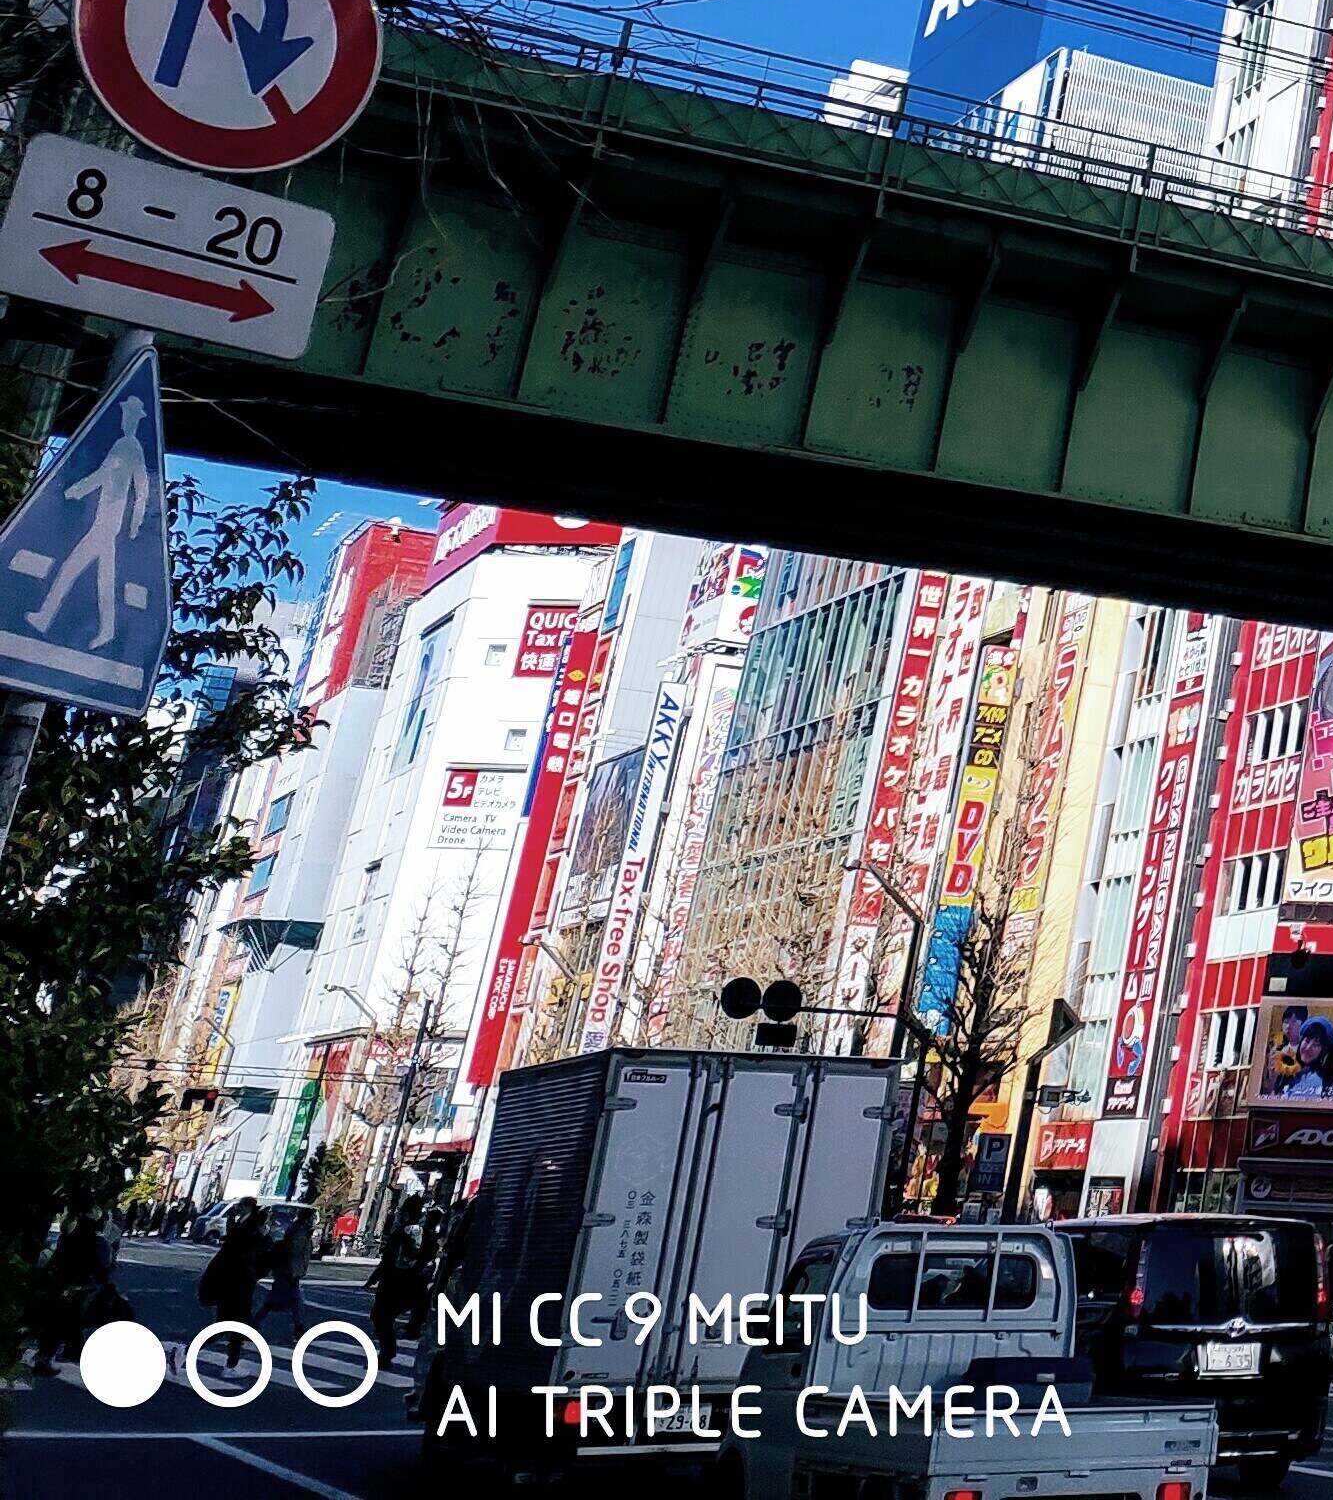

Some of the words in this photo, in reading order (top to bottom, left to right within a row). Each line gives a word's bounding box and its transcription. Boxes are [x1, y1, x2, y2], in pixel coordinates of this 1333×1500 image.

[67, 166, 108, 223] 8
[205, 204, 285, 268] 20
[529, 612, 576, 630] QUIC
[526, 630, 555, 648] Tax
[976, 705, 1007, 723] アイドル
[658, 689, 681, 771] AKKY
[975, 727, 1001, 743] アニメ
[973, 750, 992, 765] CD
[447, 775, 473, 800] 5F
[480, 774, 504, 783] カメラ
[1234, 760, 1300, 804] カラオケ
[477, 787, 501, 796] テレビ
[631, 755, 658, 853] INTERNATIONAL
[443, 813, 477, 823] Camera
[485, 813, 497, 823] TV
[437, 835, 466, 845] Drone
[441, 825, 468, 835] Video
[470, 825, 506, 835] Camera
[945, 801, 987, 896] DVD
[1124, 759, 1172, 999] クレーンゲーム
[607, 857, 646, 957] Tax-free
[592, 960, 621, 1024] Shop
[985, 1135, 1007, 1162] P
